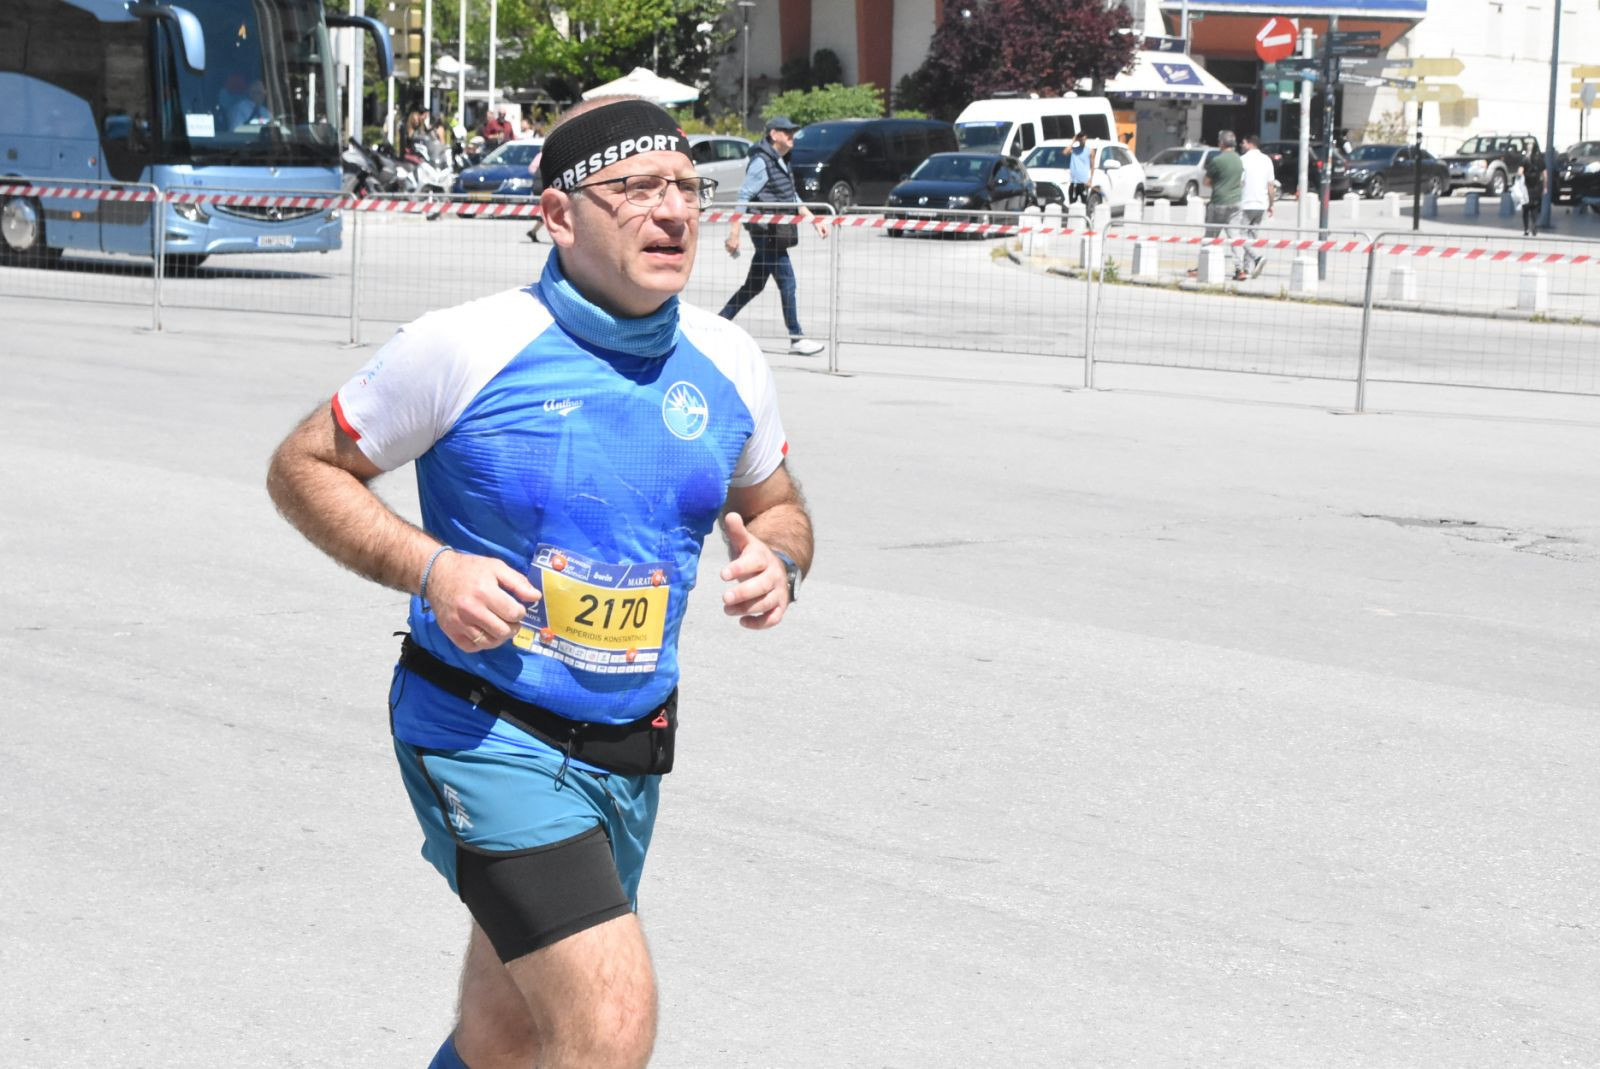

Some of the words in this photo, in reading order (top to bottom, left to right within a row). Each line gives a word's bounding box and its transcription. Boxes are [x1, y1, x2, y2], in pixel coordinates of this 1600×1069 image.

[627, 575, 668, 586] MARATN
[574, 594, 648, 630] 2170
[565, 626, 602, 641] PIPERIDIS
[604, 634, 647, 643] KONSTANTINOS
